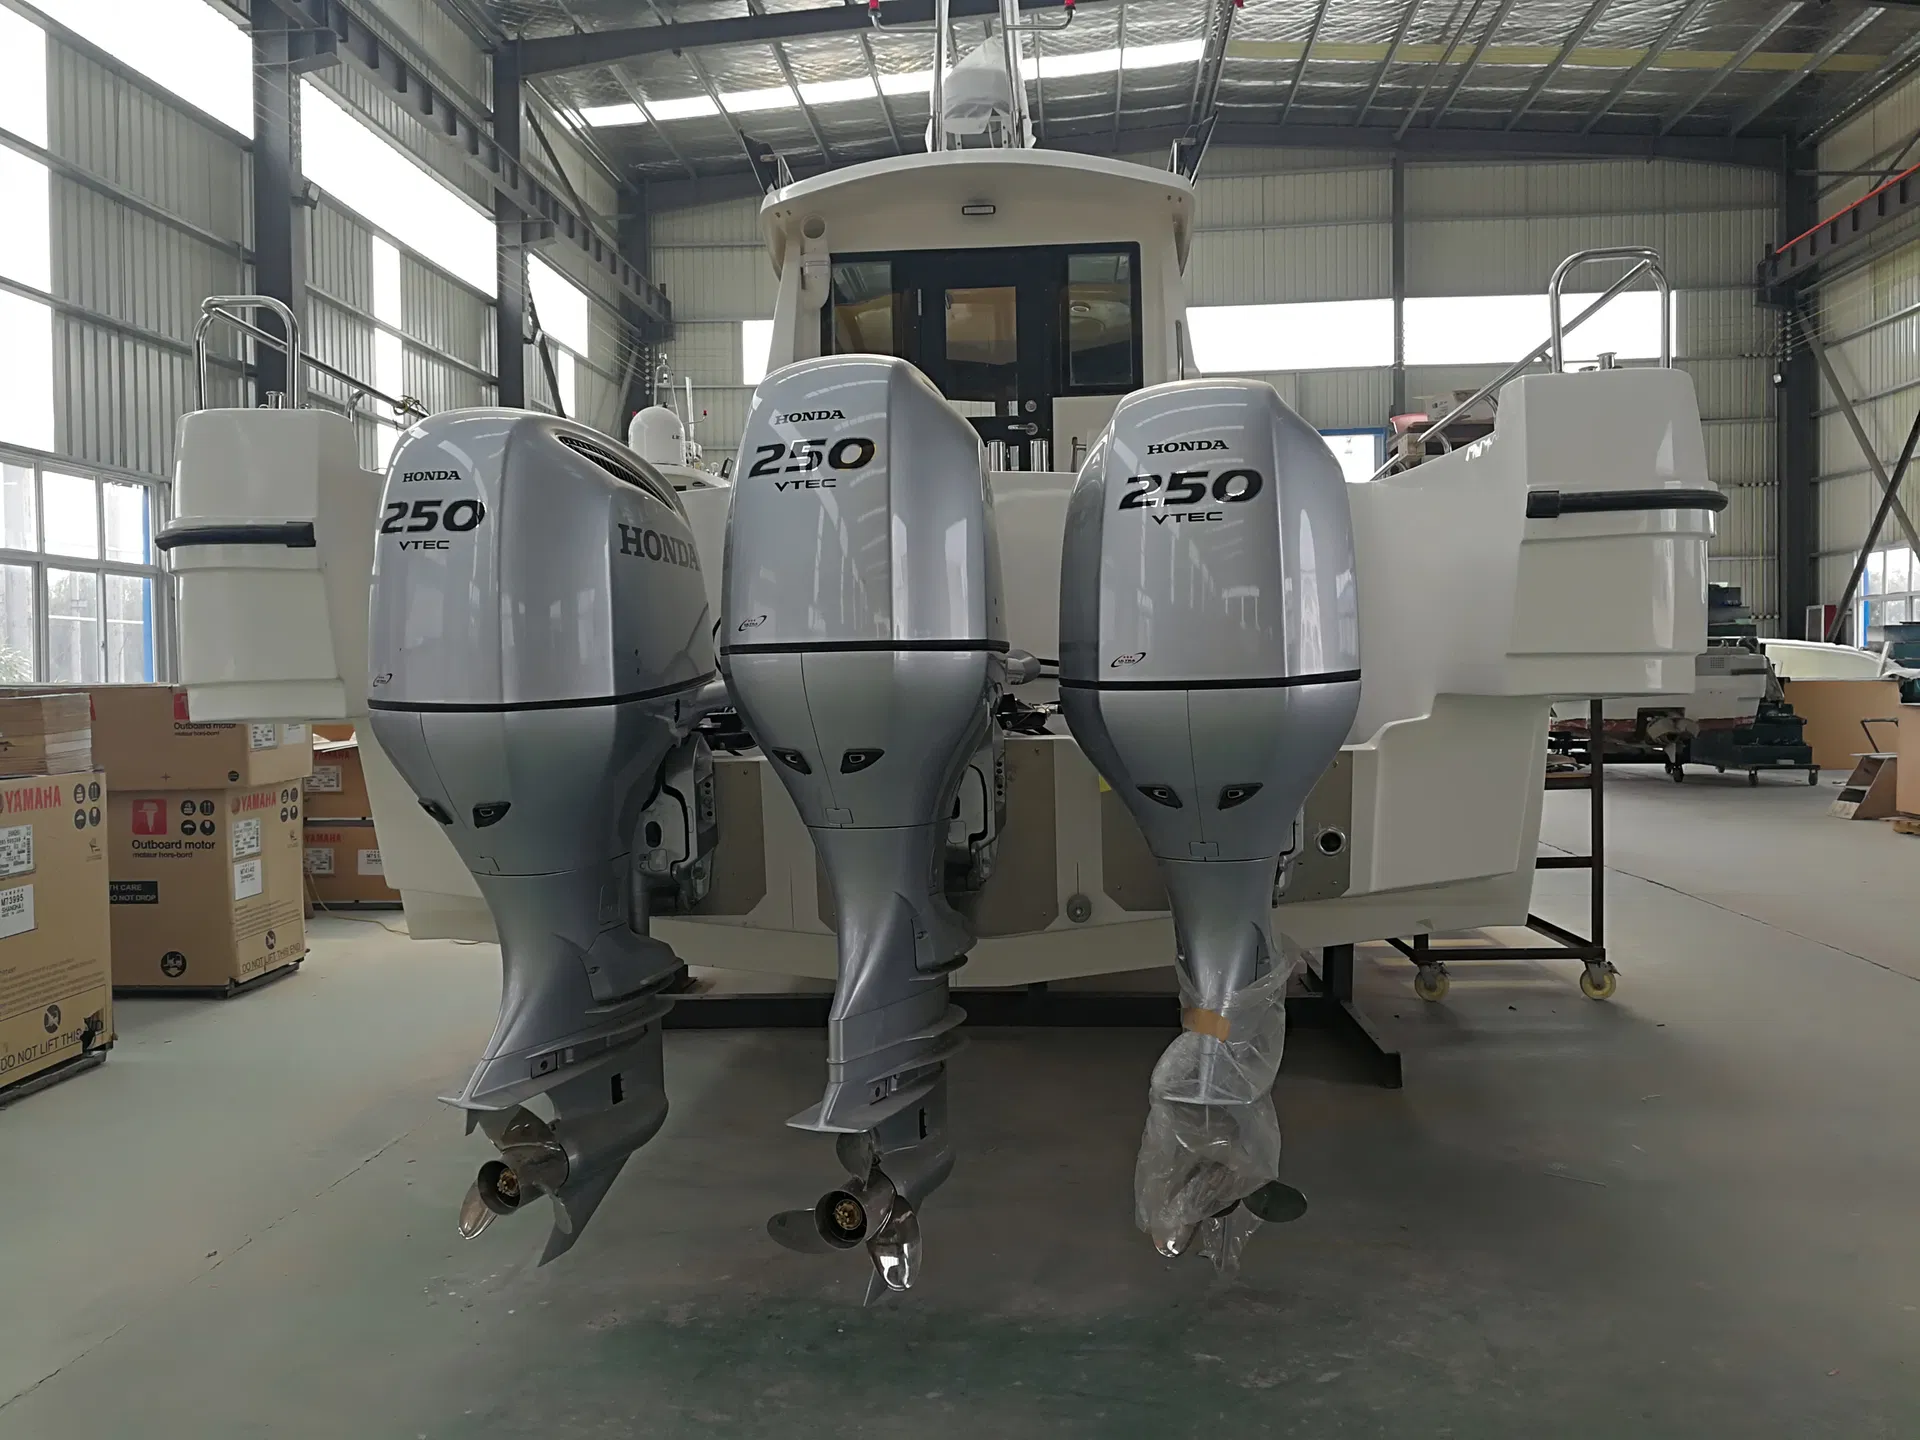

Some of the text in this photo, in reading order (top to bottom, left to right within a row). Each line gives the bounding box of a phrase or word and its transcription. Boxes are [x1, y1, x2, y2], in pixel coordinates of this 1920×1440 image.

[774, 409, 846, 425] HONDA
[1147, 440, 1230, 455] HONDA
[748, 437, 876, 479] 250
[402, 470, 461, 483] HONDA
[774, 478, 837, 492] VTEC
[1118, 468, 1263, 510] 250
[381, 499, 486, 534] 250
[1152, 511, 1223, 525] VTEC
[399, 540, 450, 551] VTEC
[618, 523, 701, 572] HONDA
[173, 722, 212, 730] Outboard
[4, 785, 62, 814] YAMAHA
[241, 791, 277, 812] YAMAHA
[132, 840, 216, 850] Outboard motor
[304, 833, 342, 843] YAMAHA
[242, 963, 251, 973] DO
[252, 957, 263, 971] NOT
[0, 1054, 16, 1071] DO
[17, 1045, 38, 1062] NOT
[40, 1037, 60, 1055] LIFT
[61, 1028, 82, 1046] THIS
